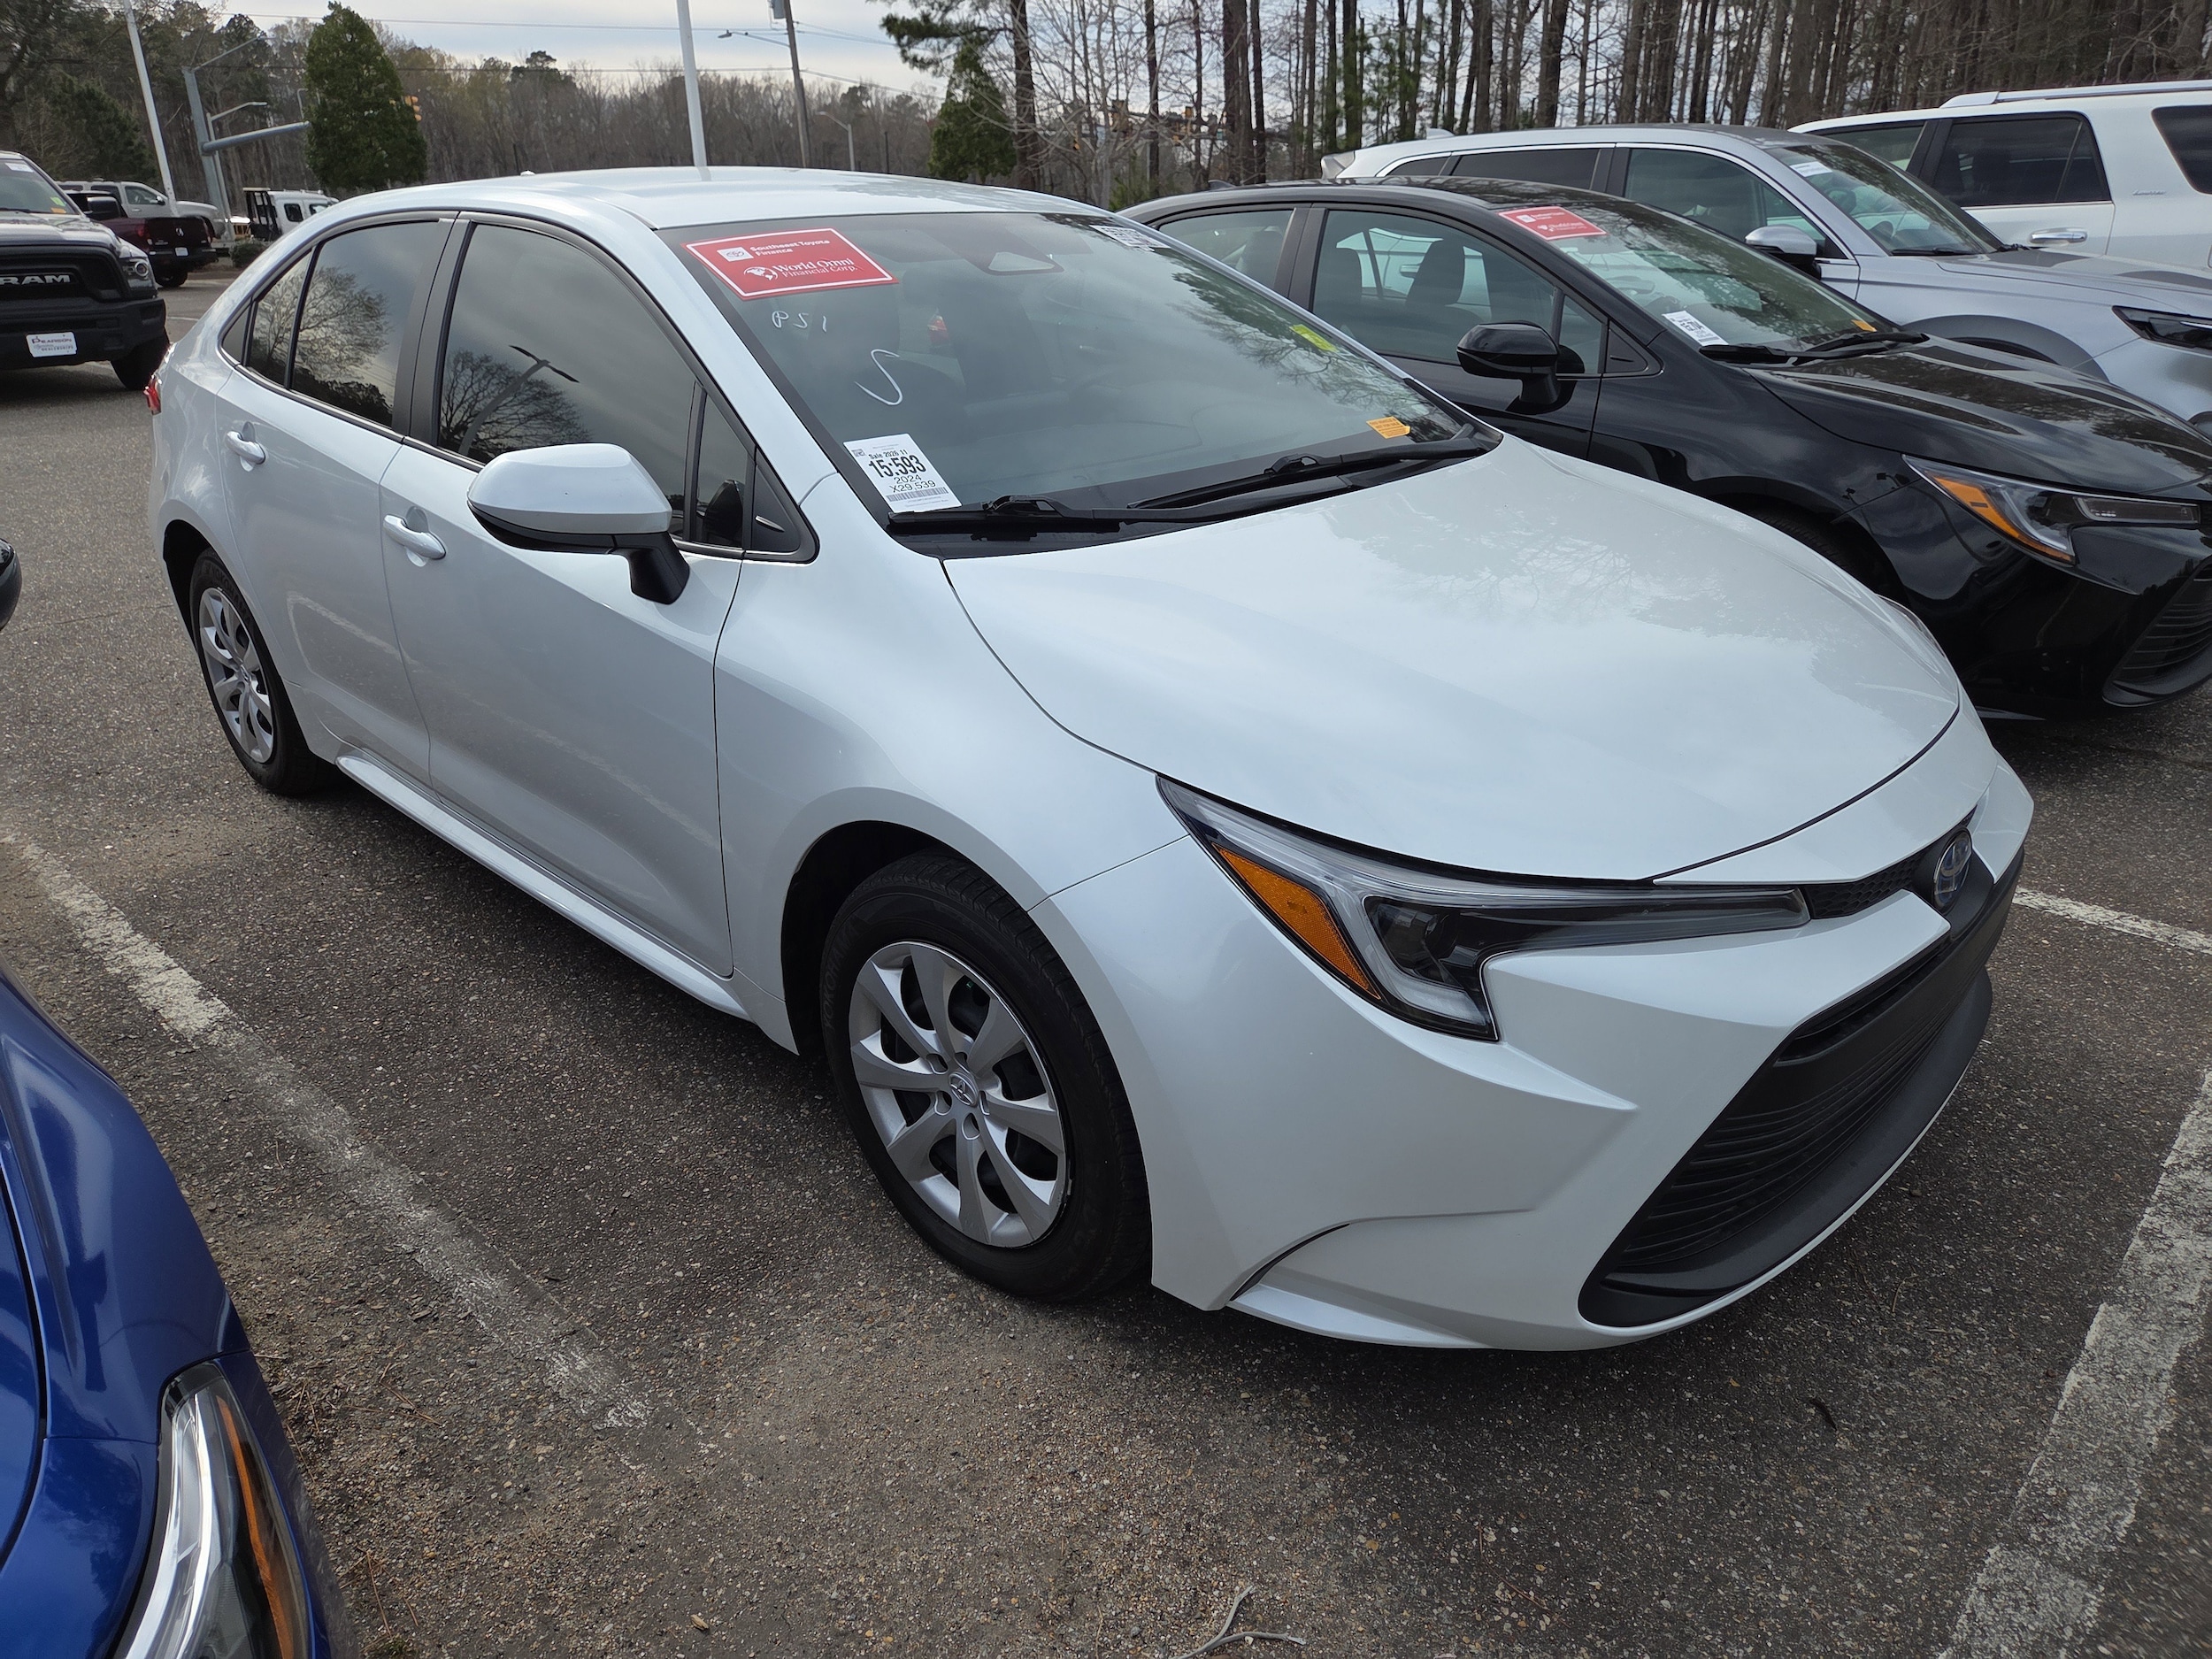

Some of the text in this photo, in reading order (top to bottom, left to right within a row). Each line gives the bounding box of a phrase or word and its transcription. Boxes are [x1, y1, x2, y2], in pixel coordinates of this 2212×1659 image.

[750, 242, 799, 251] Southeast
[772, 257, 854, 272] World Omni
[782, 266, 829, 278] Financial
[0, 274, 71, 285] RAM
[868, 455, 926, 478] 15:593
[894, 474, 922, 484] 2024
[888, 480, 936, 493] X29,539
